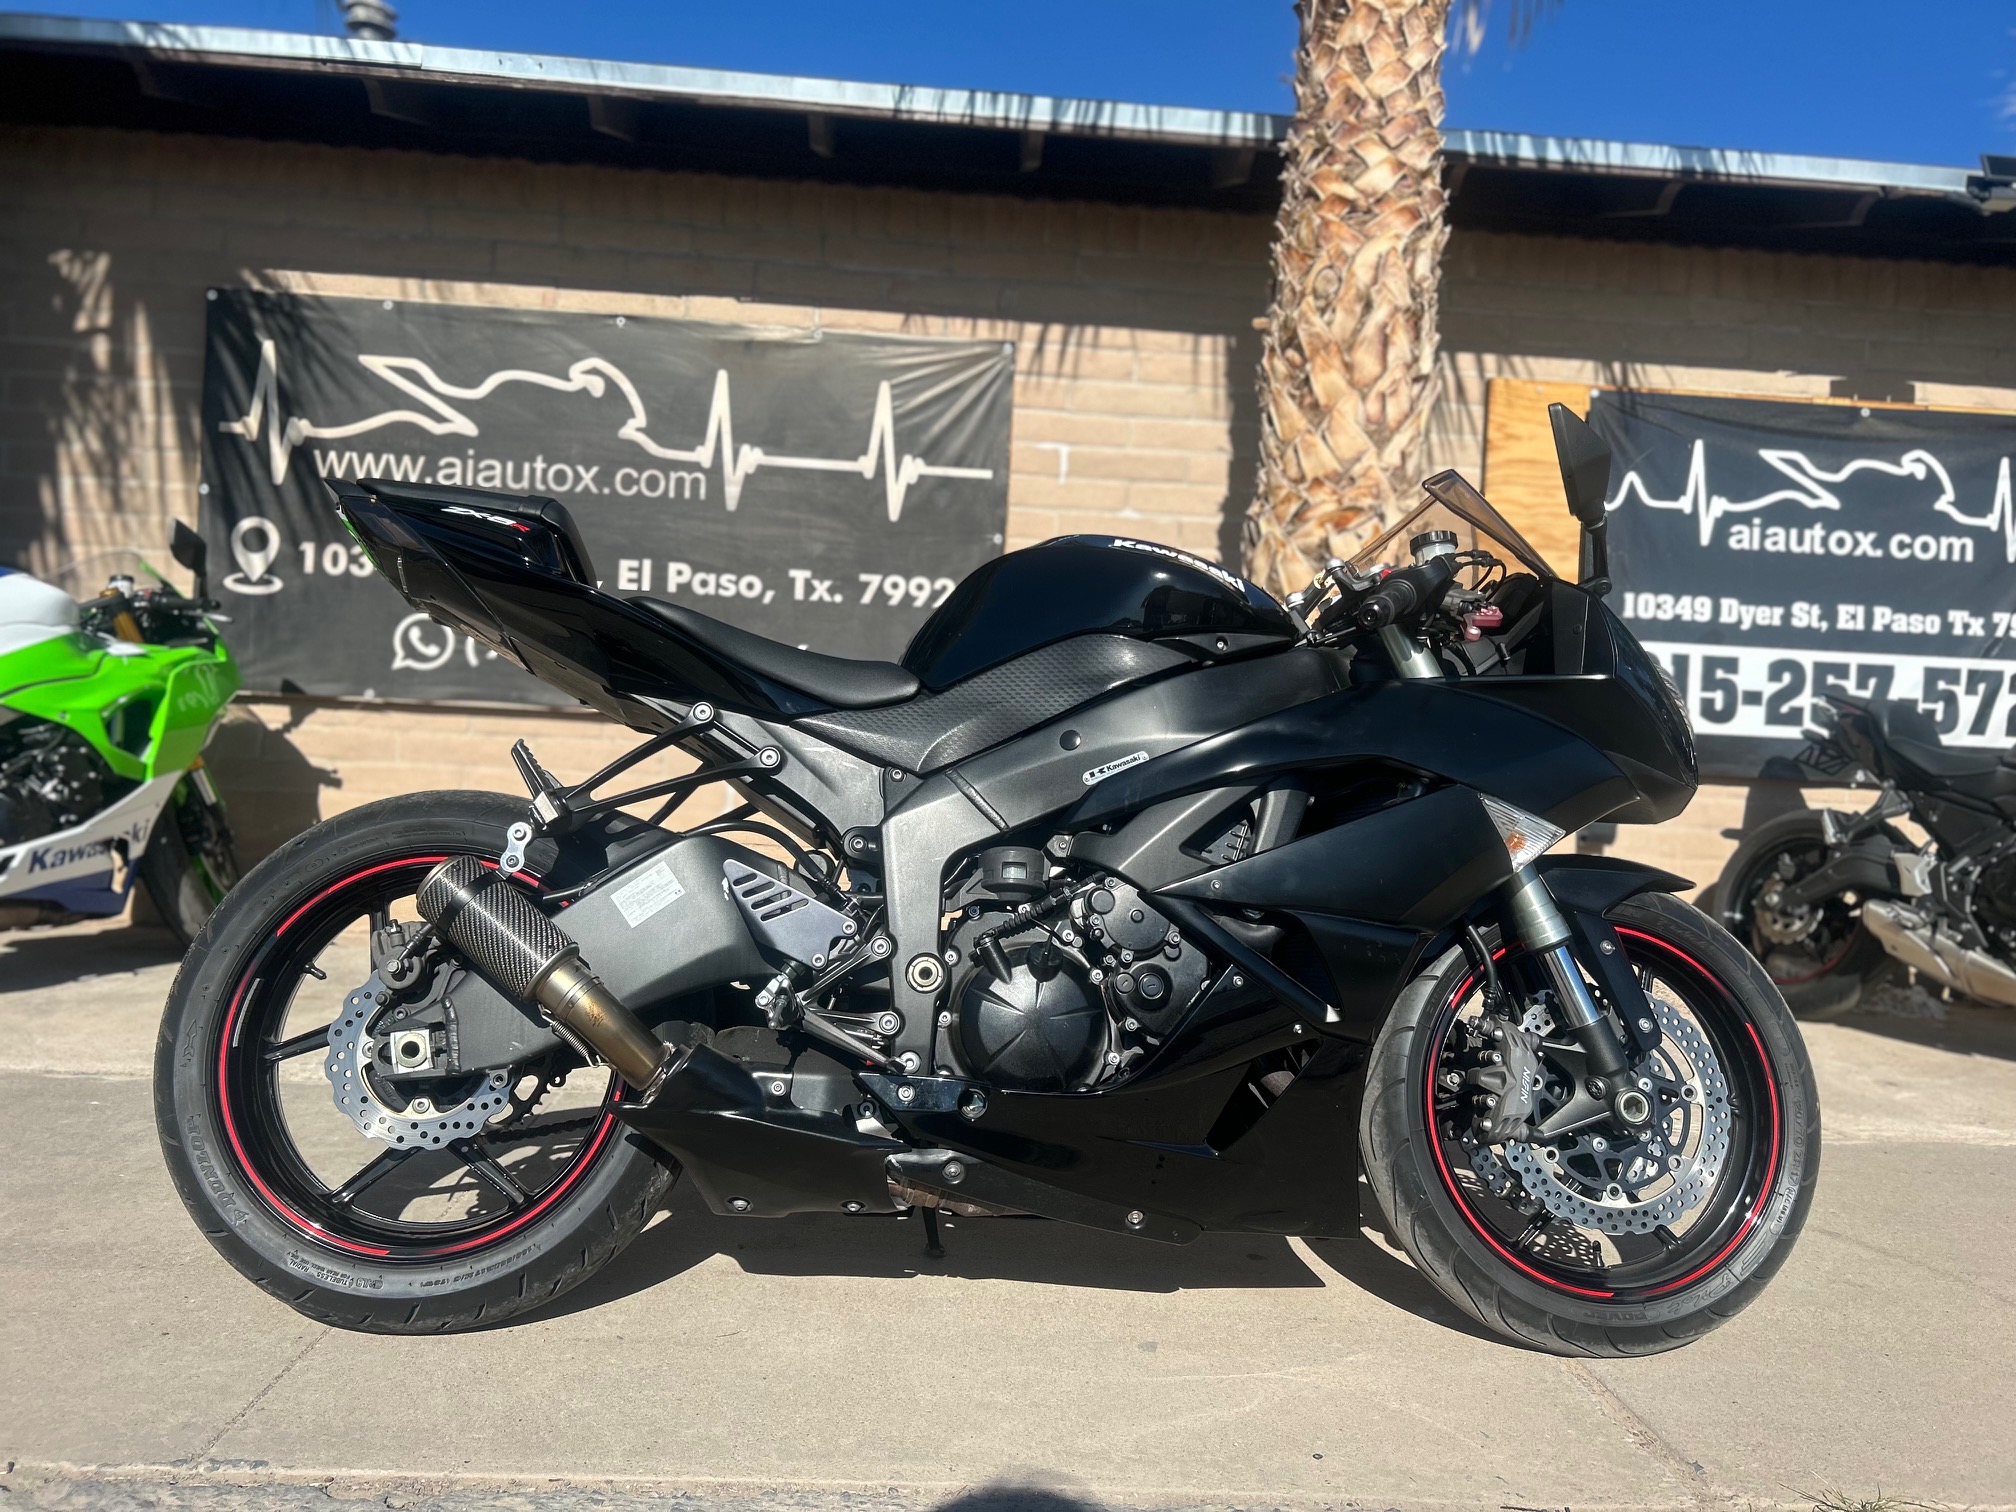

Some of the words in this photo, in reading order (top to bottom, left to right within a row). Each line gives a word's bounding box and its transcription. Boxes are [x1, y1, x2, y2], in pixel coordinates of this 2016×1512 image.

[313, 448, 707, 499] www.aiautox.com
[1728, 517, 1975, 563] aiautox.com
[298, 541, 376, 578] 103
[617, 558, 653, 592] El
[667, 561, 776, 605] Paso,
[788, 568, 844, 604] Tx.
[859, 573, 957, 609] 7992
[1112, 538, 1246, 592] Kawasaki
[1622, 591, 1711, 622] 10349
[1720, 597, 1784, 631] Dyer
[1790, 600, 1828, 632] St,
[1836, 604, 1866, 632] El
[1872, 605, 1941, 636] Paso
[1948, 609, 1986, 638] Tx
[1106, 754, 1141, 772] Kawasaki
[314, 1268, 348, 1289] TUBELESS
